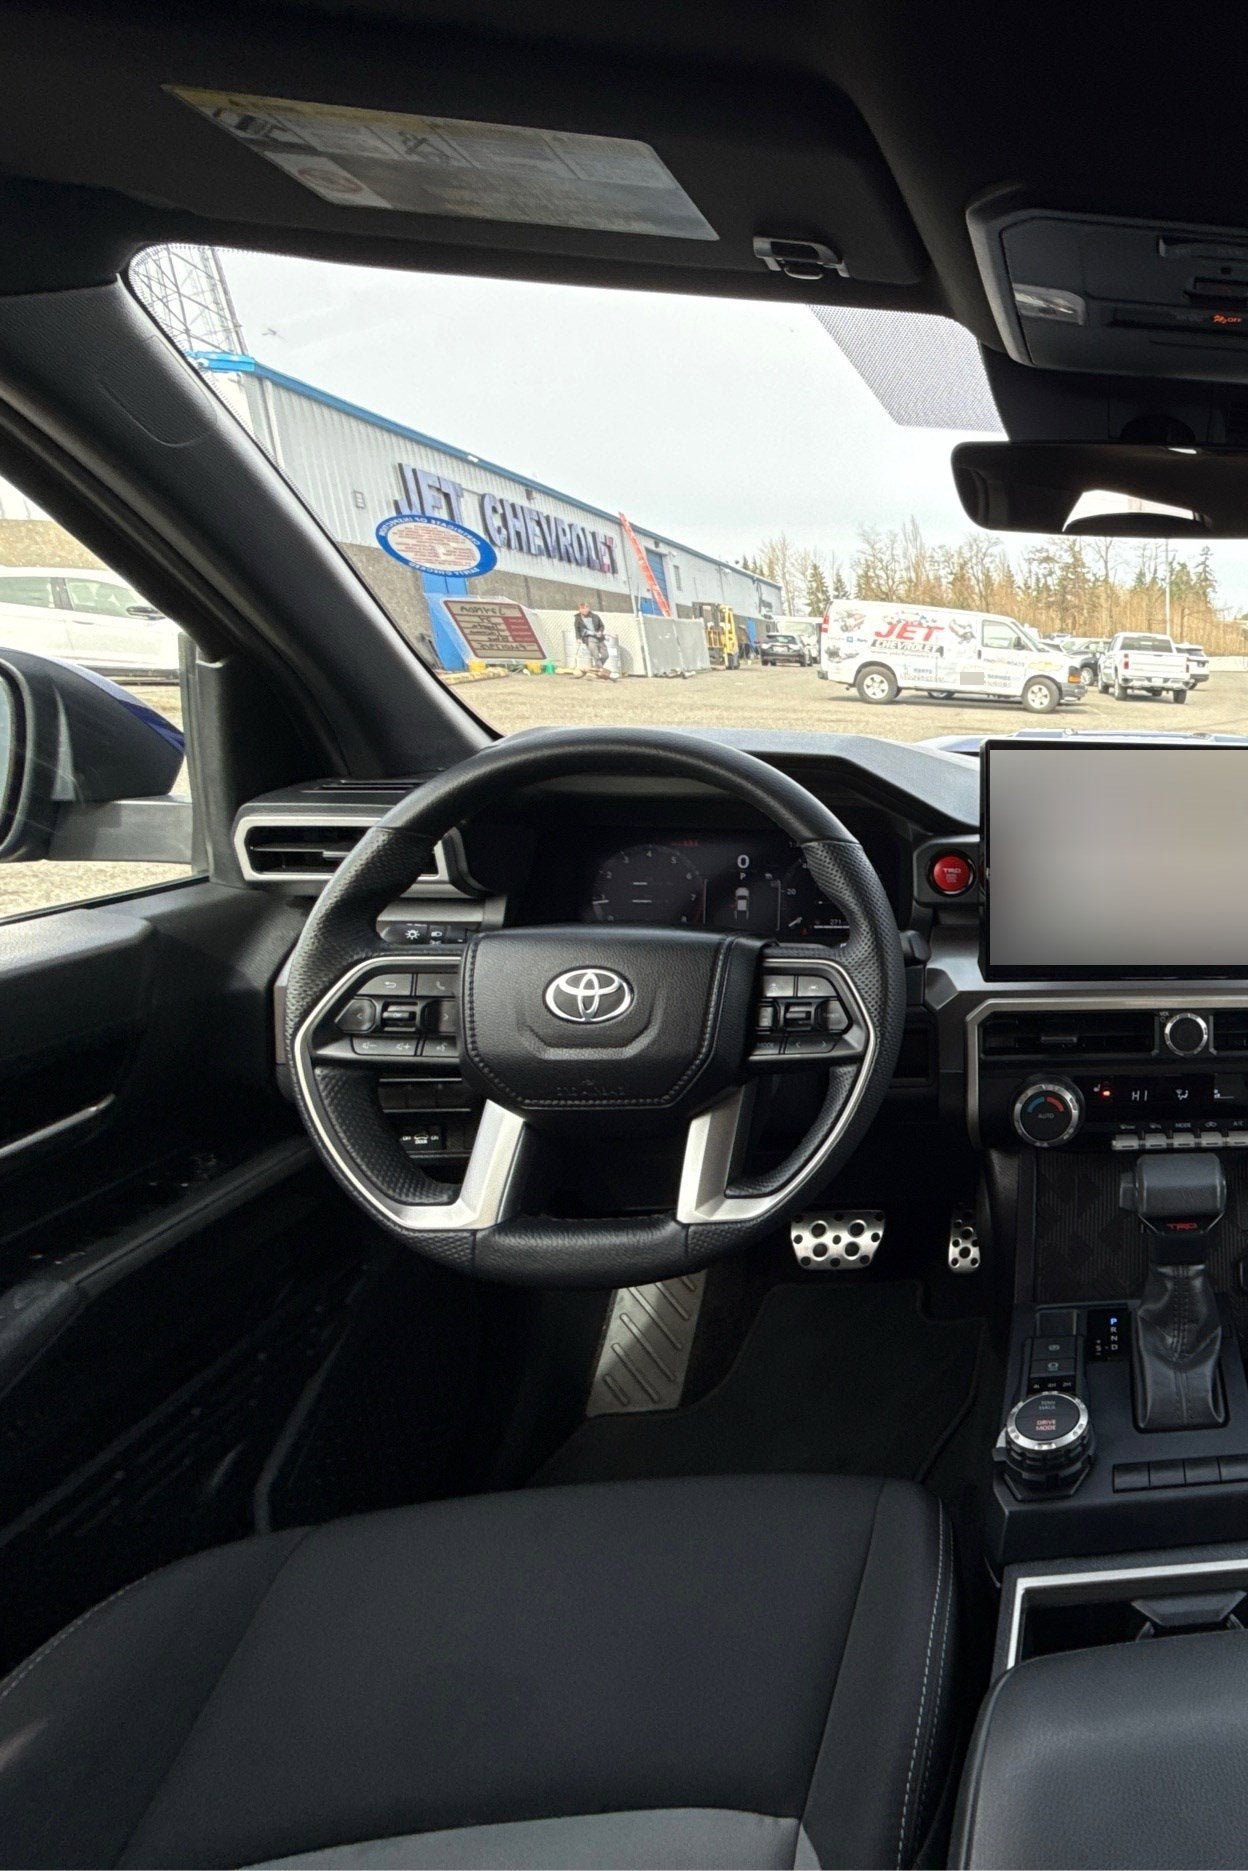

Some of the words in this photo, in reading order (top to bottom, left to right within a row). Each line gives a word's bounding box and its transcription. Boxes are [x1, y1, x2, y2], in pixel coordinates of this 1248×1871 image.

[392, 462, 464, 524] JET
[478, 492, 619, 575] CHEVROLET
[874, 622, 945, 642] JET
[872, 638, 942, 653] CHEVROLET
[737, 853, 750, 869] 0
[1131, 1089, 1149, 1102] HI
[1166, 1222, 1200, 1231] TRD
